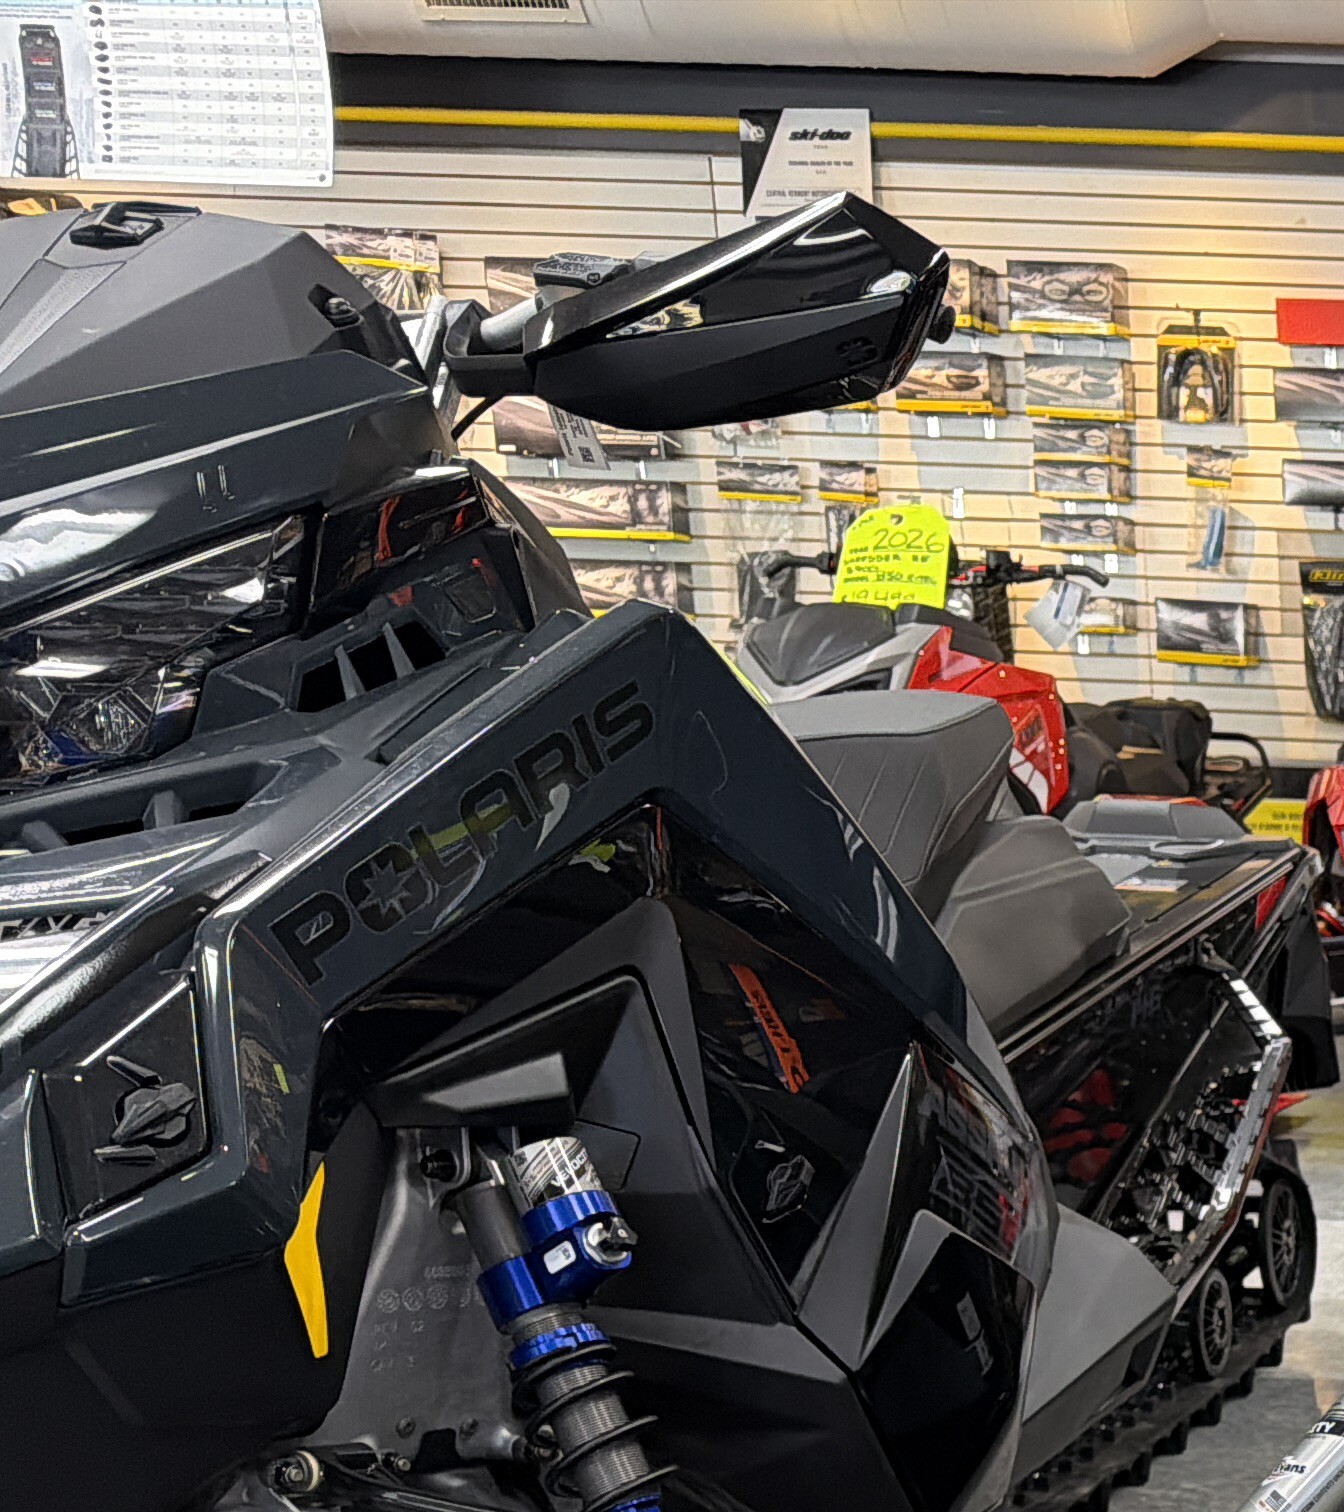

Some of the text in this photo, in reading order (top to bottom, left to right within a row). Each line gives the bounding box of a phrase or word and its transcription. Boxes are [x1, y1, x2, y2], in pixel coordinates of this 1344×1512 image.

[788, 128, 853, 142] ski-doo
[873, 527, 945, 553] 2026
[268, 678, 655, 988] POLARIS
